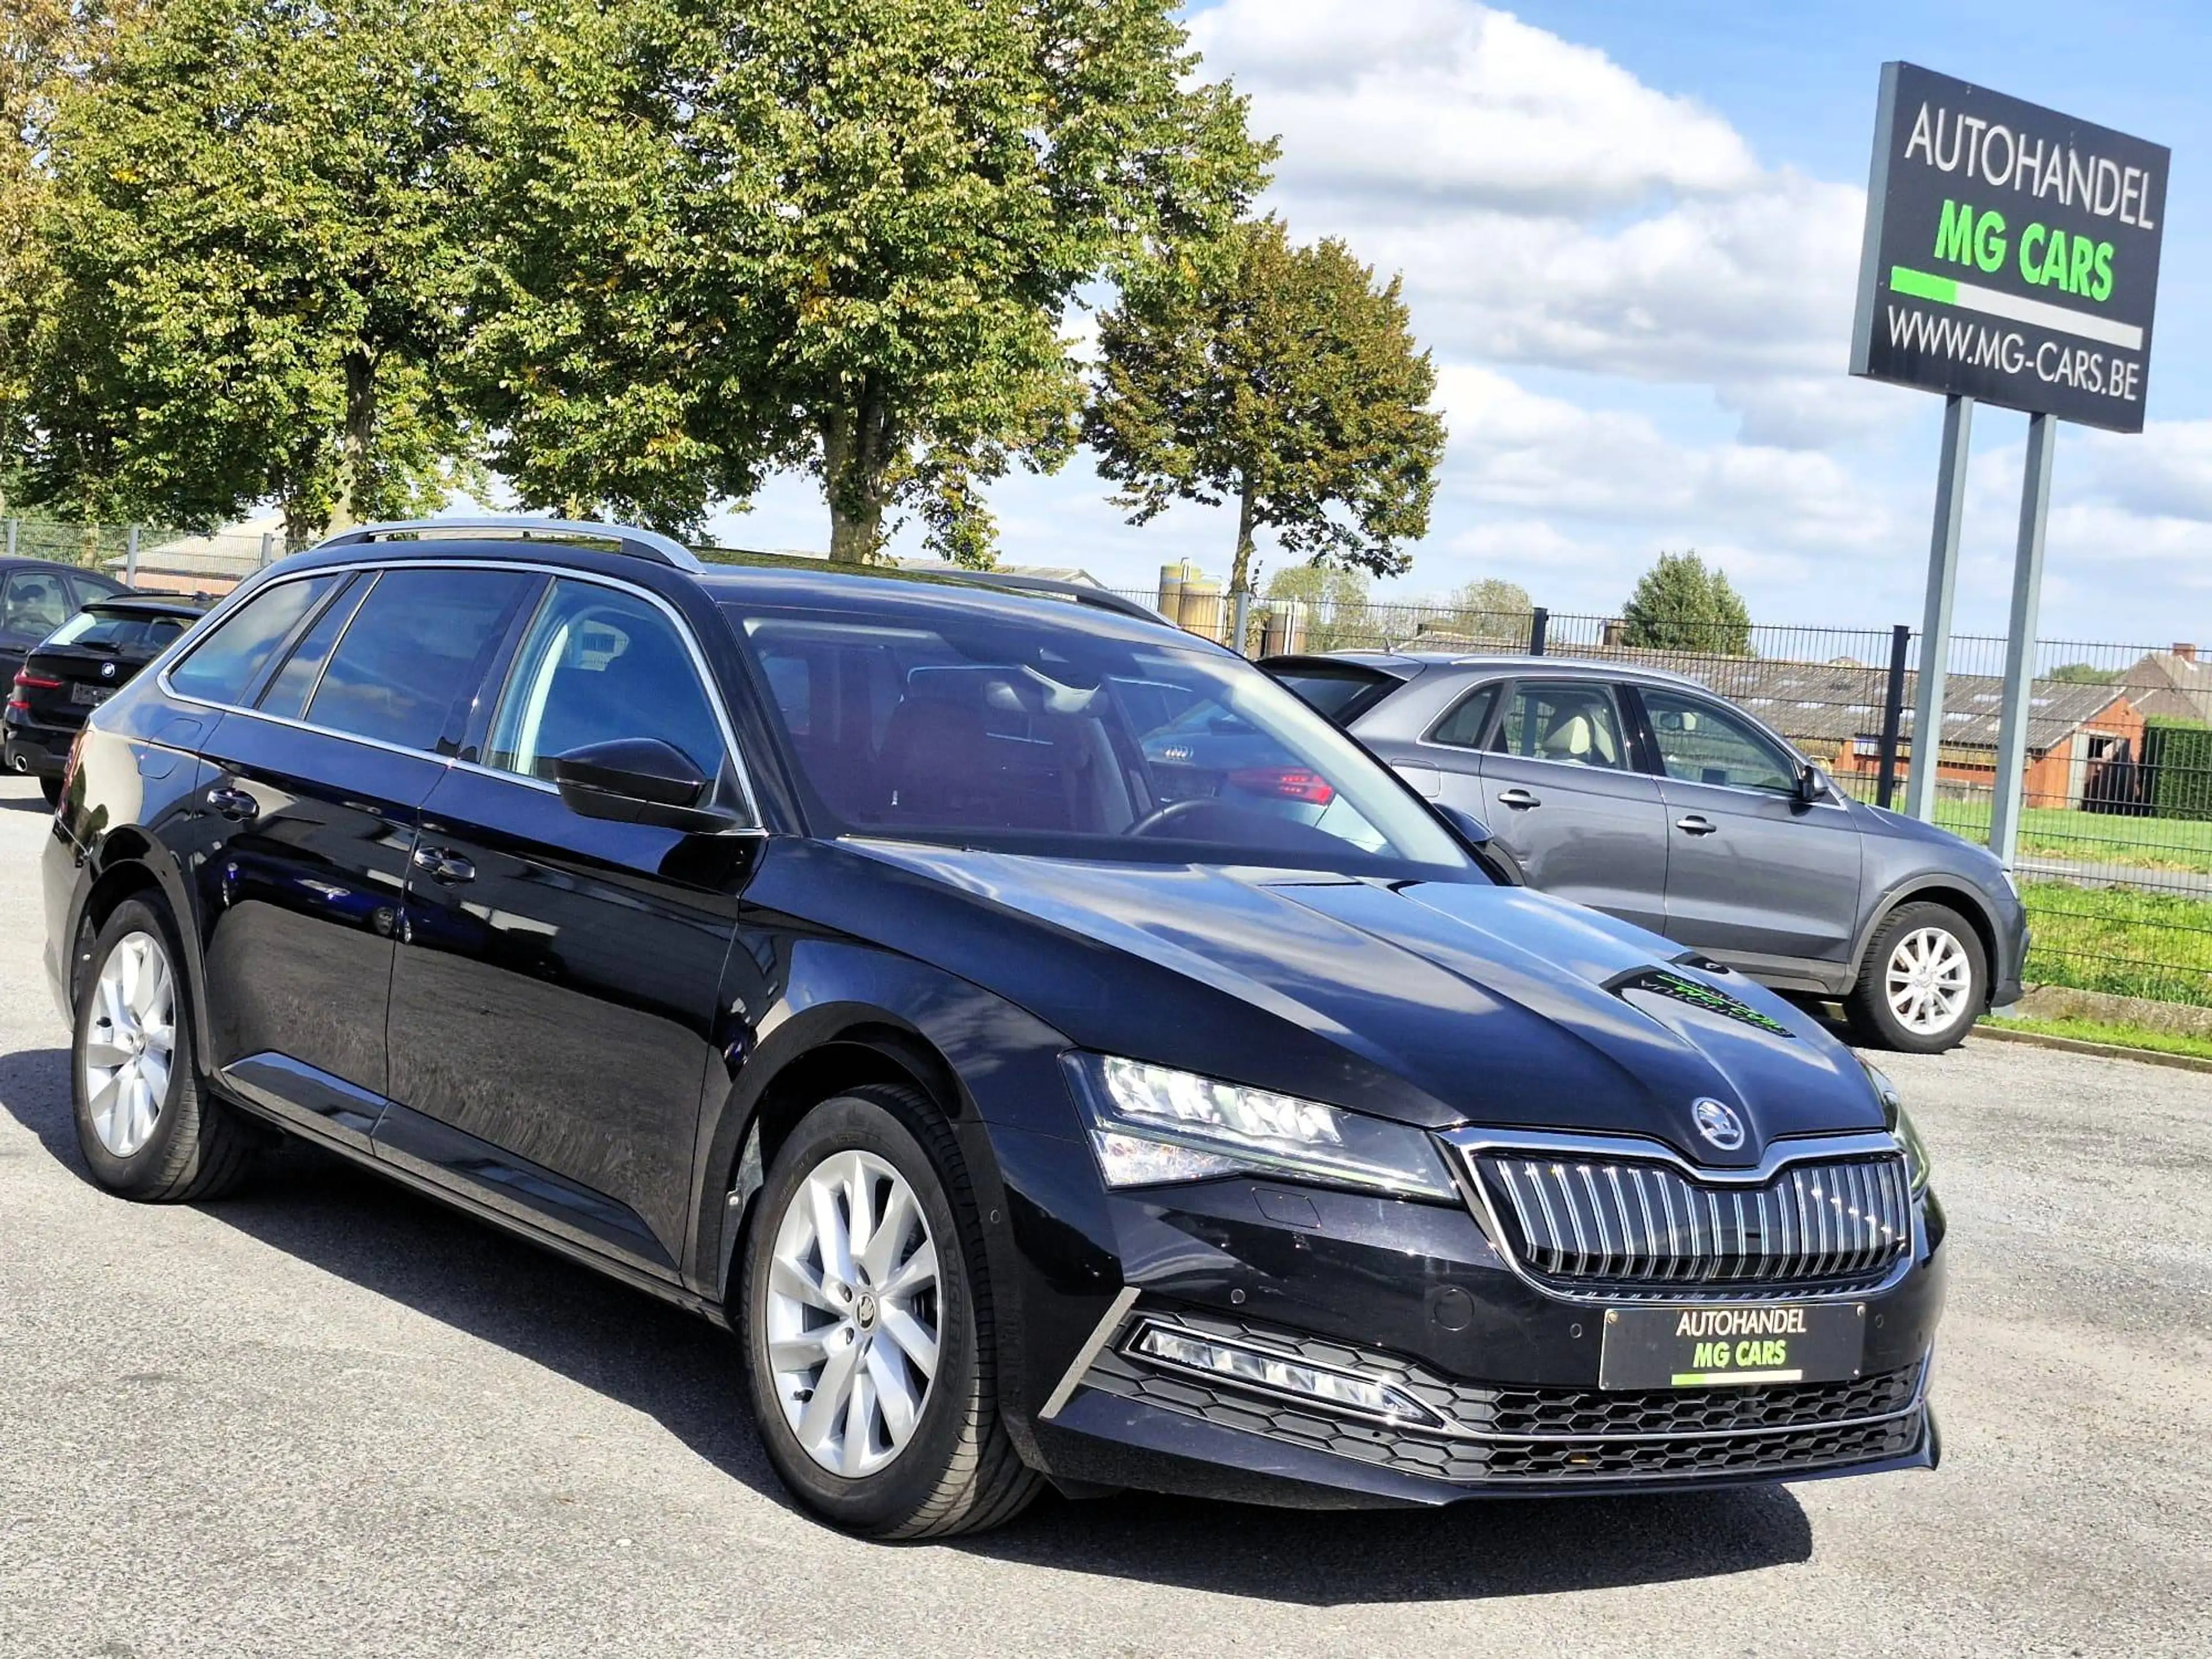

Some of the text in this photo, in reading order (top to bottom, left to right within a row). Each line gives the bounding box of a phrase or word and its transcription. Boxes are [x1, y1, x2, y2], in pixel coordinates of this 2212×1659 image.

[1904, 101, 2154, 230] AUTOHANDEL
[1934, 199, 2114, 301] MG CARS
[1887, 305, 2141, 401] WWW.MG-CARS.BE
[1675, 1308, 1807, 1337] AUTOHANDEL
[1692, 1339, 1787, 1368] MG CARS
